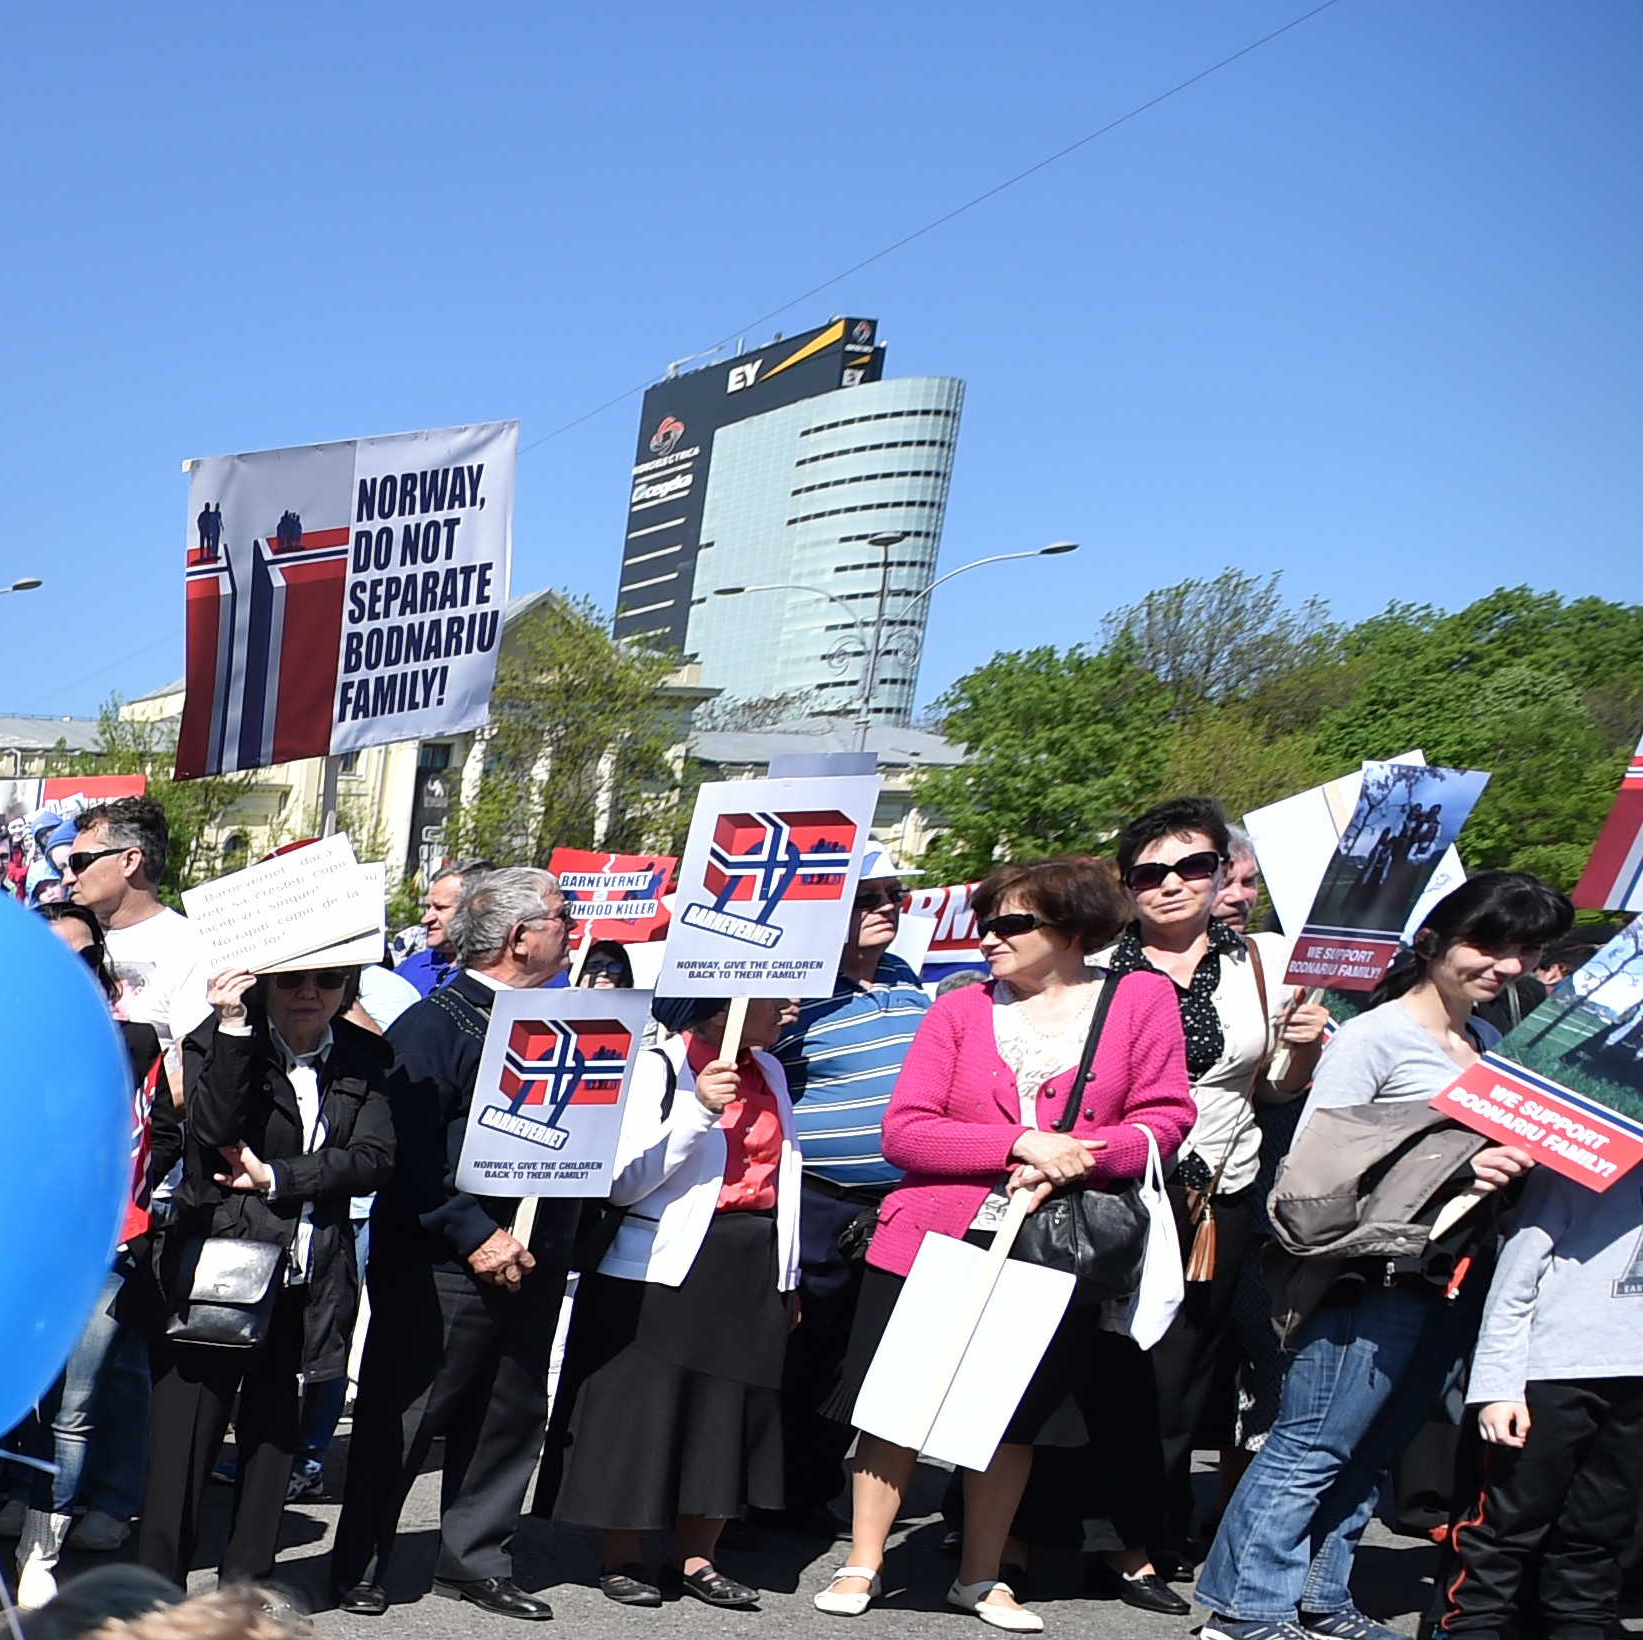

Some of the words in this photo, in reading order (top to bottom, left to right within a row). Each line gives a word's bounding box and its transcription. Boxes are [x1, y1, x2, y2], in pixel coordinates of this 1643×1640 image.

[727, 358, 764, 394] EY
[356, 463, 486, 522] NORWAY,
[352, 527, 393, 574] DO
[400, 518, 461, 567] NOT
[348, 562, 494, 624] SEPARATE
[343, 610, 499, 674] BODNARIU
[338, 666, 449, 722] FAMILY!
[561, 875, 649, 888] BARNEVERNET
[616, 903, 655, 915] KILLER
[684, 905, 782, 947] BARNEVERNET
[676, 961, 721, 971] NORWAY,
[724, 961, 746, 969] GIVE
[750, 961, 768, 969] THE
[771, 961, 823, 969] CHILDREN
[1289, 960, 1337, 975] BODNARIU
[1337, 964, 1382, 979] FAMILY!
[1307, 946, 1323, 958] WE
[1323, 947, 1374, 963] SUPPORT
[688, 971, 715, 979] BACK
[719, 971, 731, 979] TO
[734, 971, 763, 979] THEIR
[766, 971, 807, 979] FAMILY!
[481, 1108, 568, 1149] BARNEVERNET
[1447, 1086, 1546, 1141] BODNARIU
[1541, 1134, 1617, 1177] FAMILY!
[1489, 1084, 1523, 1109] WE
[1519, 1100, 1610, 1149] SUPPORT
[473, 1160, 514, 1171] NORWAY,
[517, 1161, 538, 1170] GIVE
[541, 1161, 556, 1170] THE
[559, 1161, 603, 1170] CHILDREN
[484, 1171, 509, 1179] BACK
[513, 1171, 523, 1179] TO
[526, 1171, 551, 1179] THEIR
[554, 1171, 589, 1180] FAMILY!
